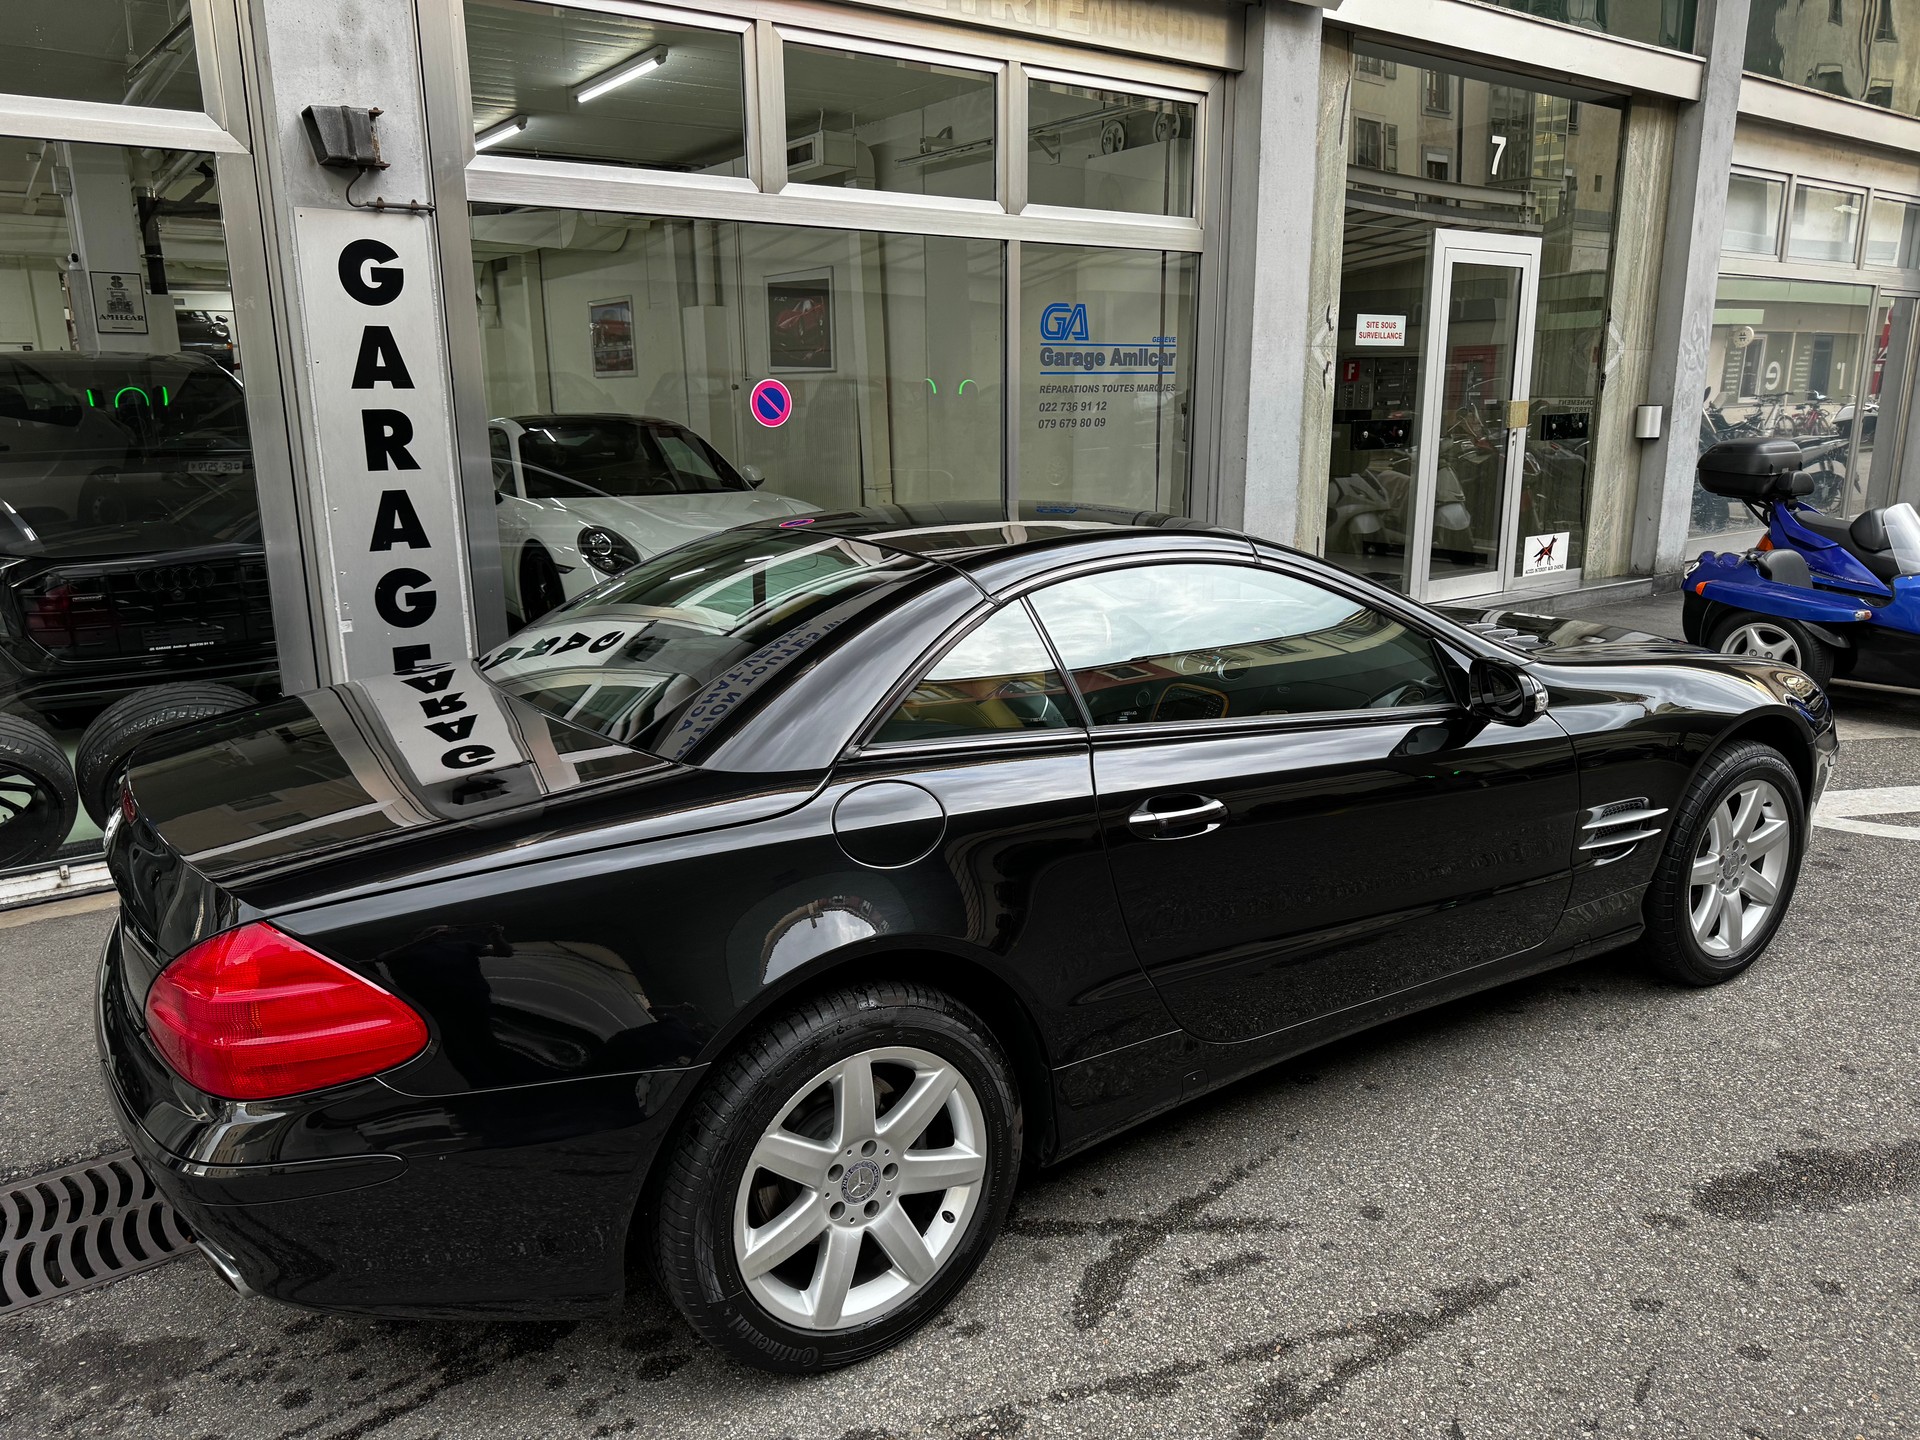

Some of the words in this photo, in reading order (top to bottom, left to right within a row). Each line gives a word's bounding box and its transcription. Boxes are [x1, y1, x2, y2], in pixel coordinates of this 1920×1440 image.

[1491, 135, 1507, 175] 7
[1040, 303, 1090, 341] GA
[1366, 321, 1380, 329] SITE
[1381, 321, 1397, 329] SOUS
[1358, 331, 1402, 340] SURVEILLANCE
[1040, 347, 1106, 371] Garage
[1347, 363, 1356, 379] F
[1039, 383, 1100, 394] RÉPARATIONS
[1102, 384, 1135, 393] TOUTES
[1136, 383, 1176, 393] MARQUES
[1039, 402, 1058, 412] 022
[1060, 401, 1078, 412] 736
[1080, 401, 1092, 411] 91
[1094, 401, 1107, 411] 12
[1038, 419, 1057, 429] 079
[1059, 418, 1077, 428] 679
[1079, 418, 1092, 427] 80
[1094, 417, 1106, 427] 09
